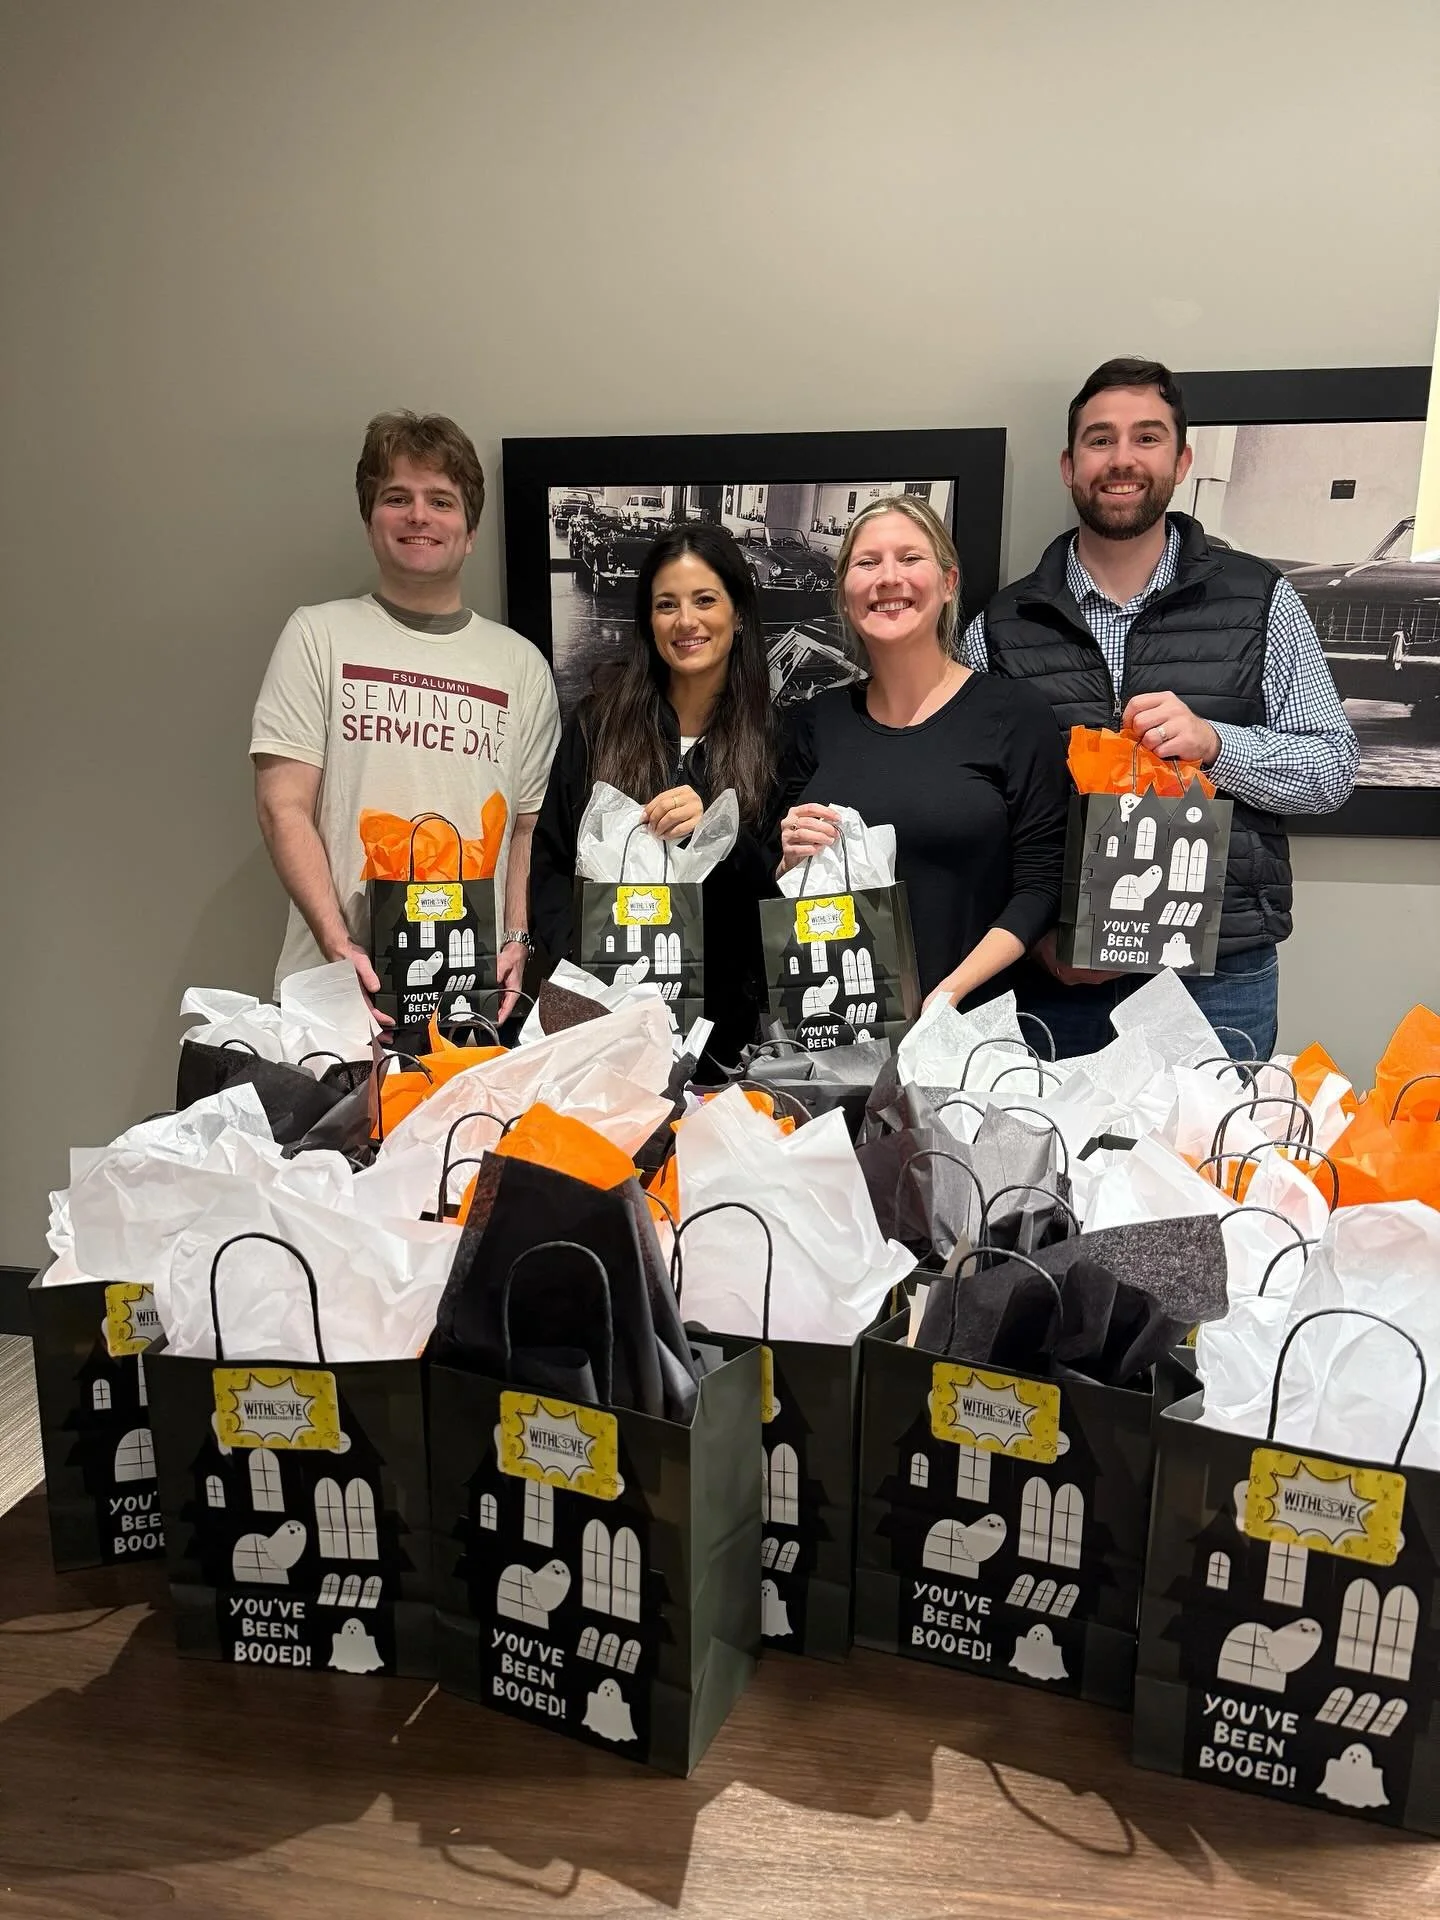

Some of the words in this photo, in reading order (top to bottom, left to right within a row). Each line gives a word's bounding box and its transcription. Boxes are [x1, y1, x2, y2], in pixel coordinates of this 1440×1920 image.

[392, 672, 417, 685] FSU
[421, 677, 470, 694] ALUMNI
[341, 682, 508, 737] SEMINOLE
[342, 714, 455, 752] SERVICE
[462, 728, 505, 764] DAY
[1102, 920, 1151, 933] YOU'VE
[1107, 933, 1144, 948] BEEN
[1100, 948, 1149, 965] BOOED!
[403, 991, 439, 1003] YOU'VE
[408, 1002, 436, 1013] BEEN
[801, 1024, 839, 1038] YOU'VE
[807, 1037, 836, 1049] BEEN
[229, 1597, 306, 1619] YOU'VE
[911, 1580, 992, 1616] YOU'VE
[242, 1617, 299, 1640] BEEN
[922, 1603, 981, 1635] BEEN
[234, 1640, 312, 1667] BOOED!
[491, 1628, 565, 1668] YOU'VE
[911, 1625, 992, 1662] BOOED!
[501, 1652, 555, 1689] BEEN
[493, 1675, 566, 1720] BOOED!
[1203, 1692, 1299, 1735] YOU'VE
[1213, 1720, 1286, 1758] BEEN
[1199, 1745, 1297, 1789] BOOED!
